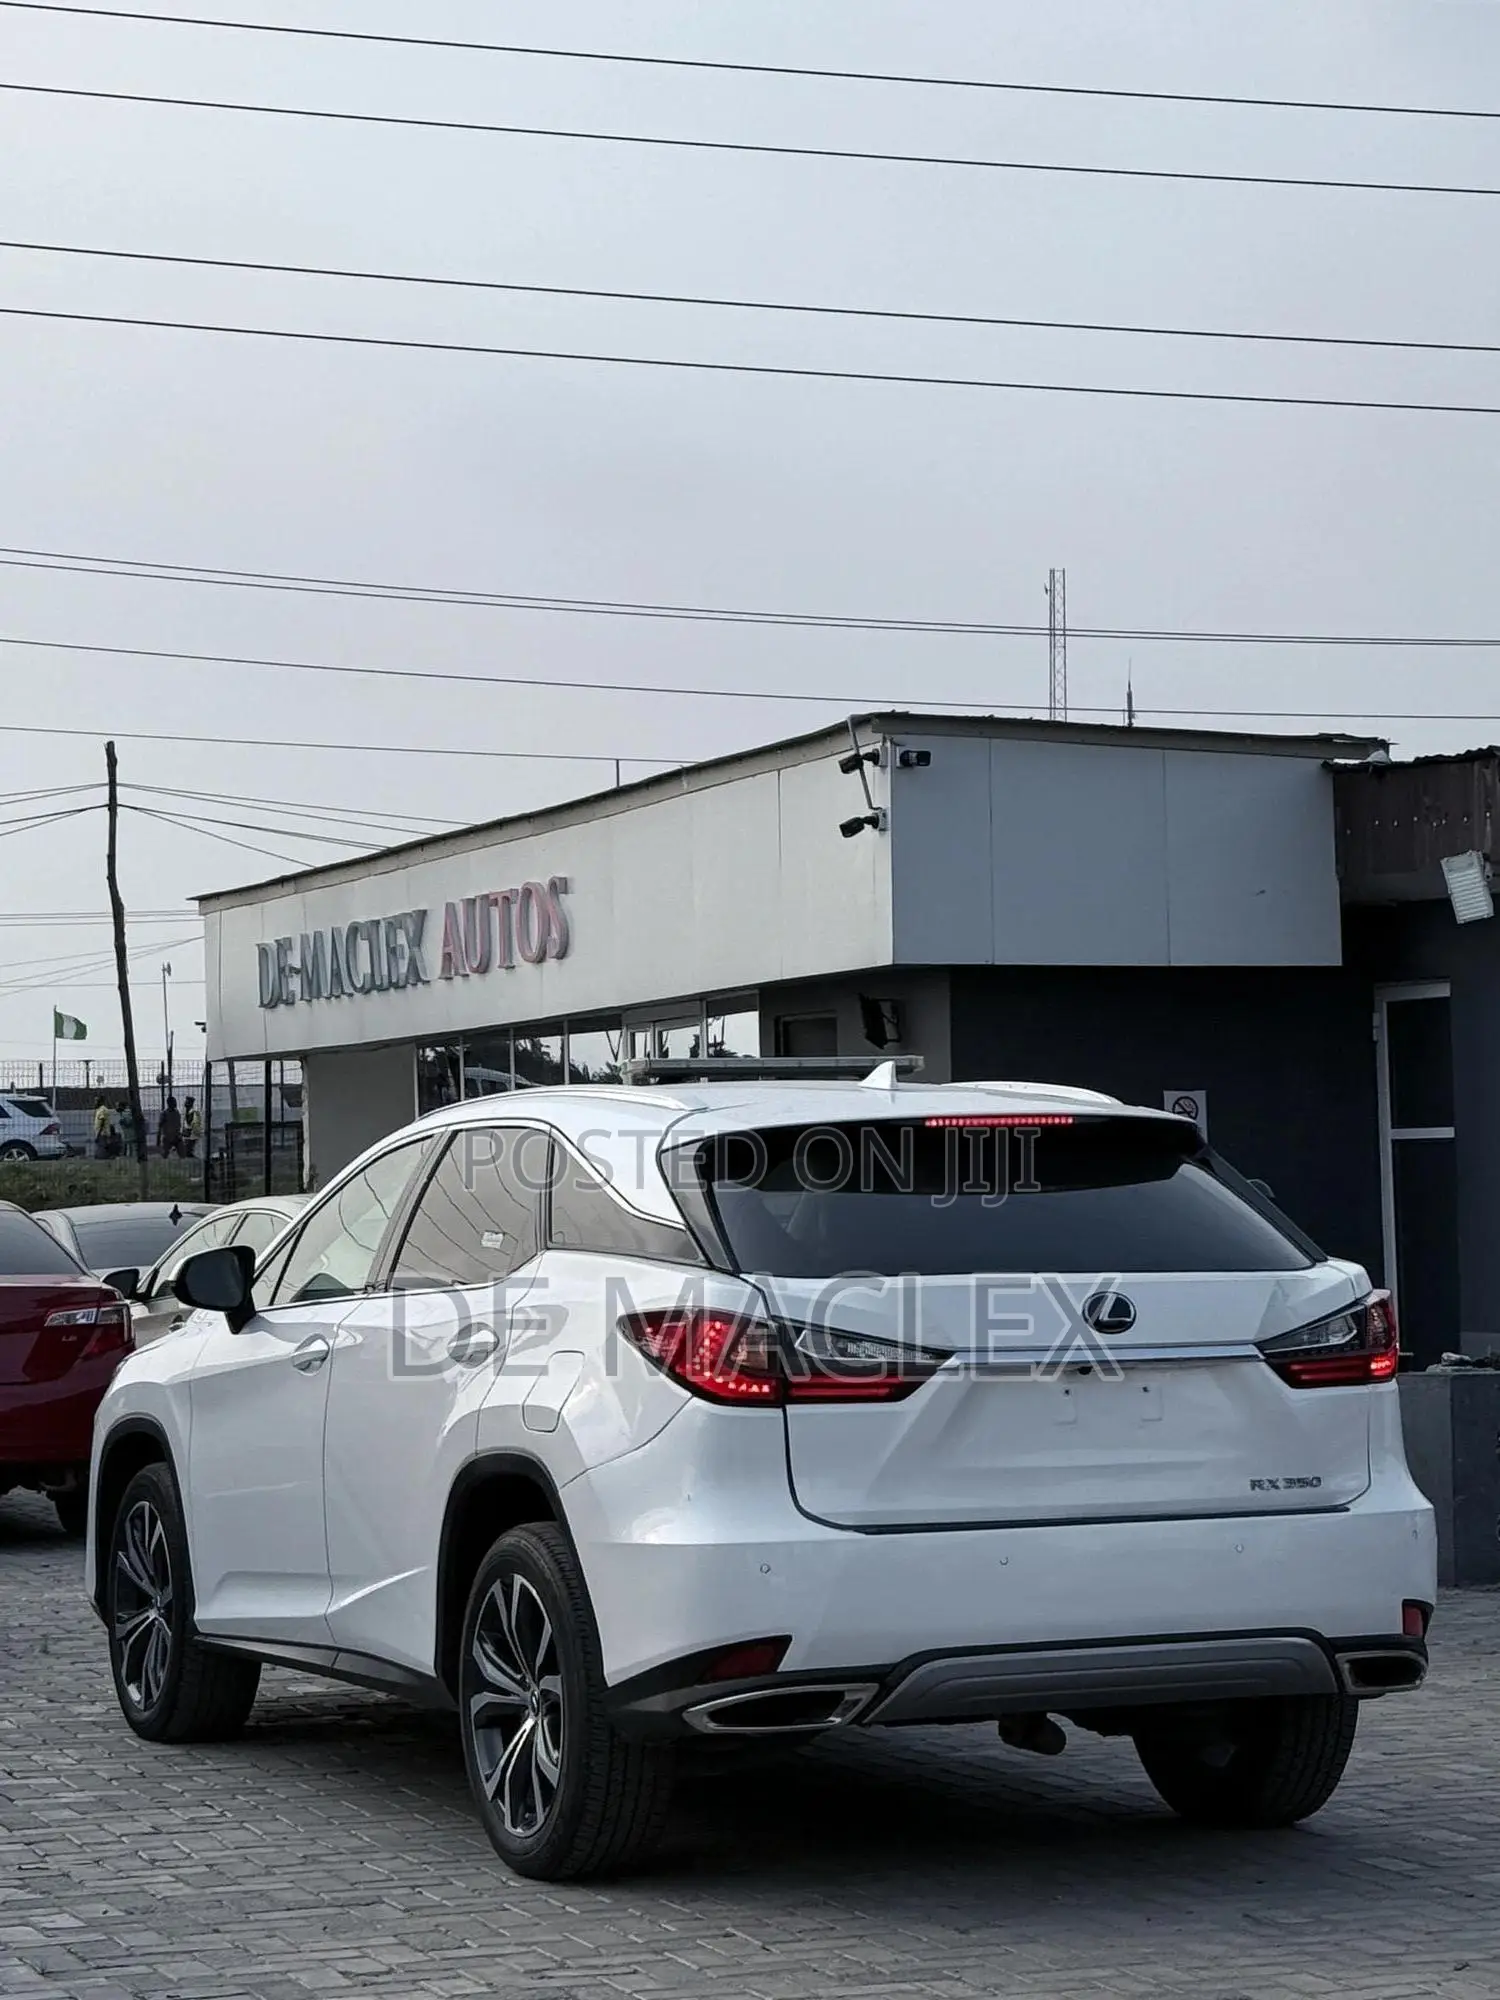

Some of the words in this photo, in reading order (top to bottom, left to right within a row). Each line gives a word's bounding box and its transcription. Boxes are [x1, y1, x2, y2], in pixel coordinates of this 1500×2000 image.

[438, 876, 571, 980] AUTOS
[1249, 1478, 1280, 1491] RX
[1281, 1476, 1322, 1490] 350
